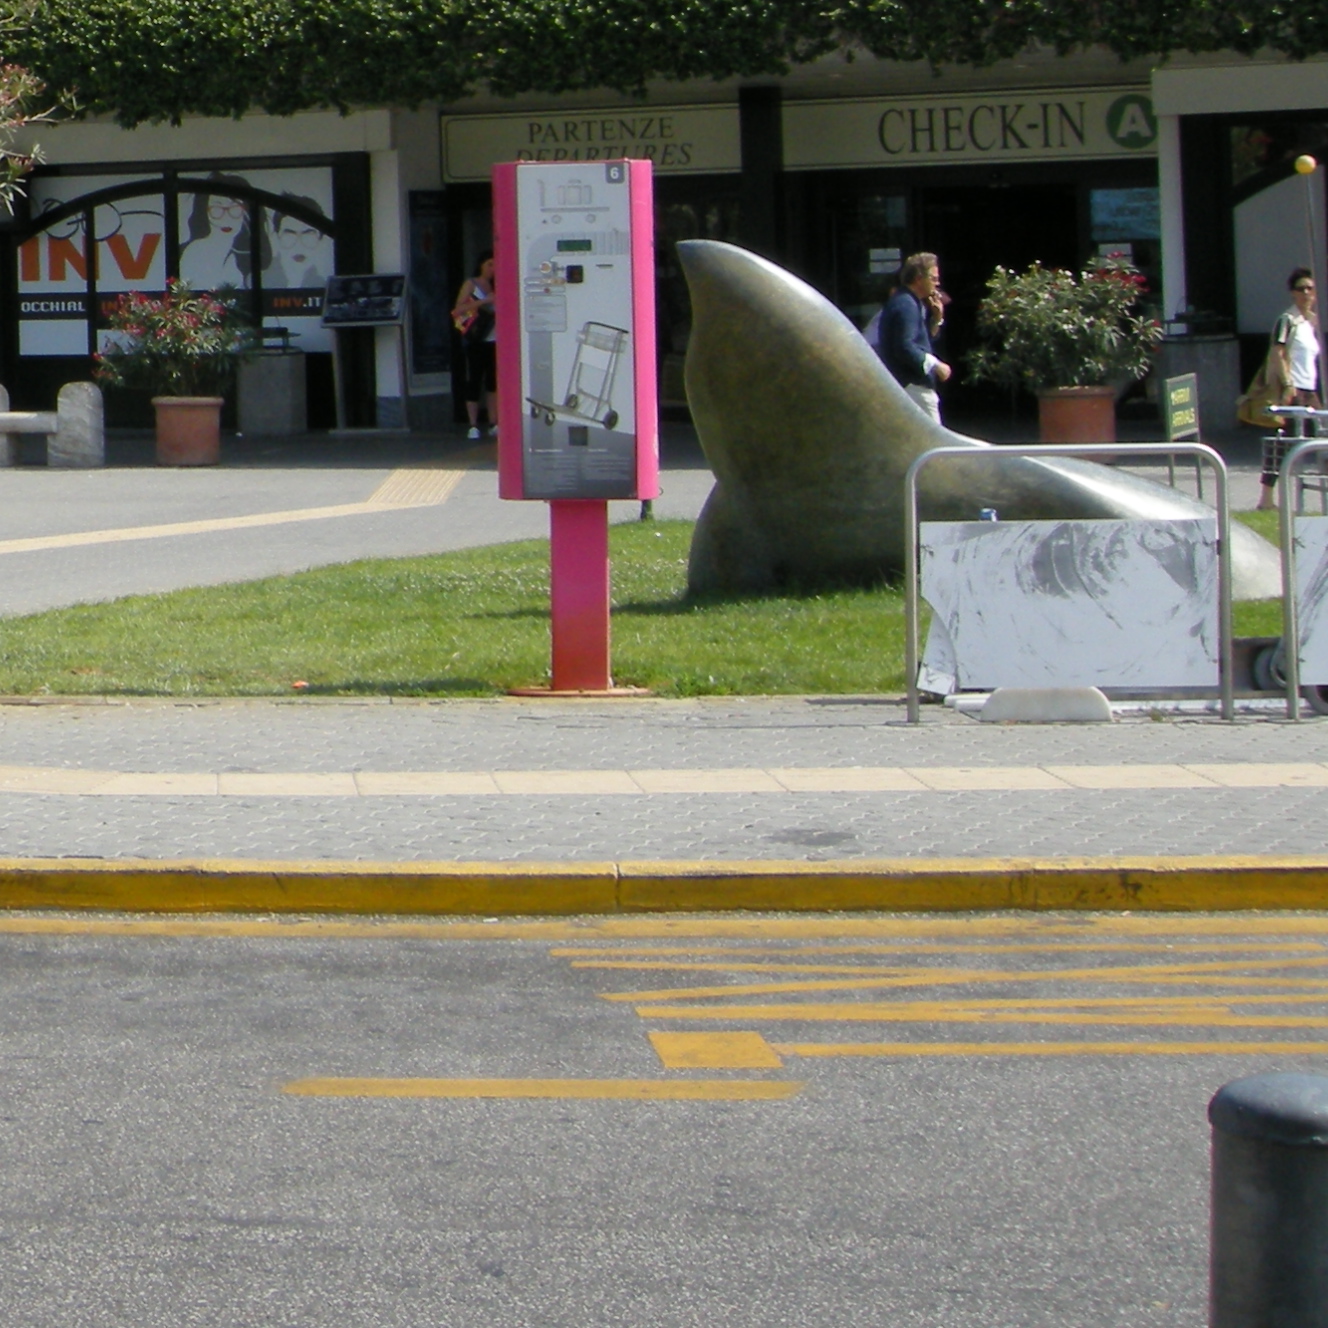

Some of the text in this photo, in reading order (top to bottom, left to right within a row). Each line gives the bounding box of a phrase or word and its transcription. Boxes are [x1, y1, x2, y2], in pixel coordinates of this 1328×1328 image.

[528, 116, 675, 144] PARTENZE
[877, 101, 1158, 154] CHECK-IN A
[609, 166, 620, 179] 6
